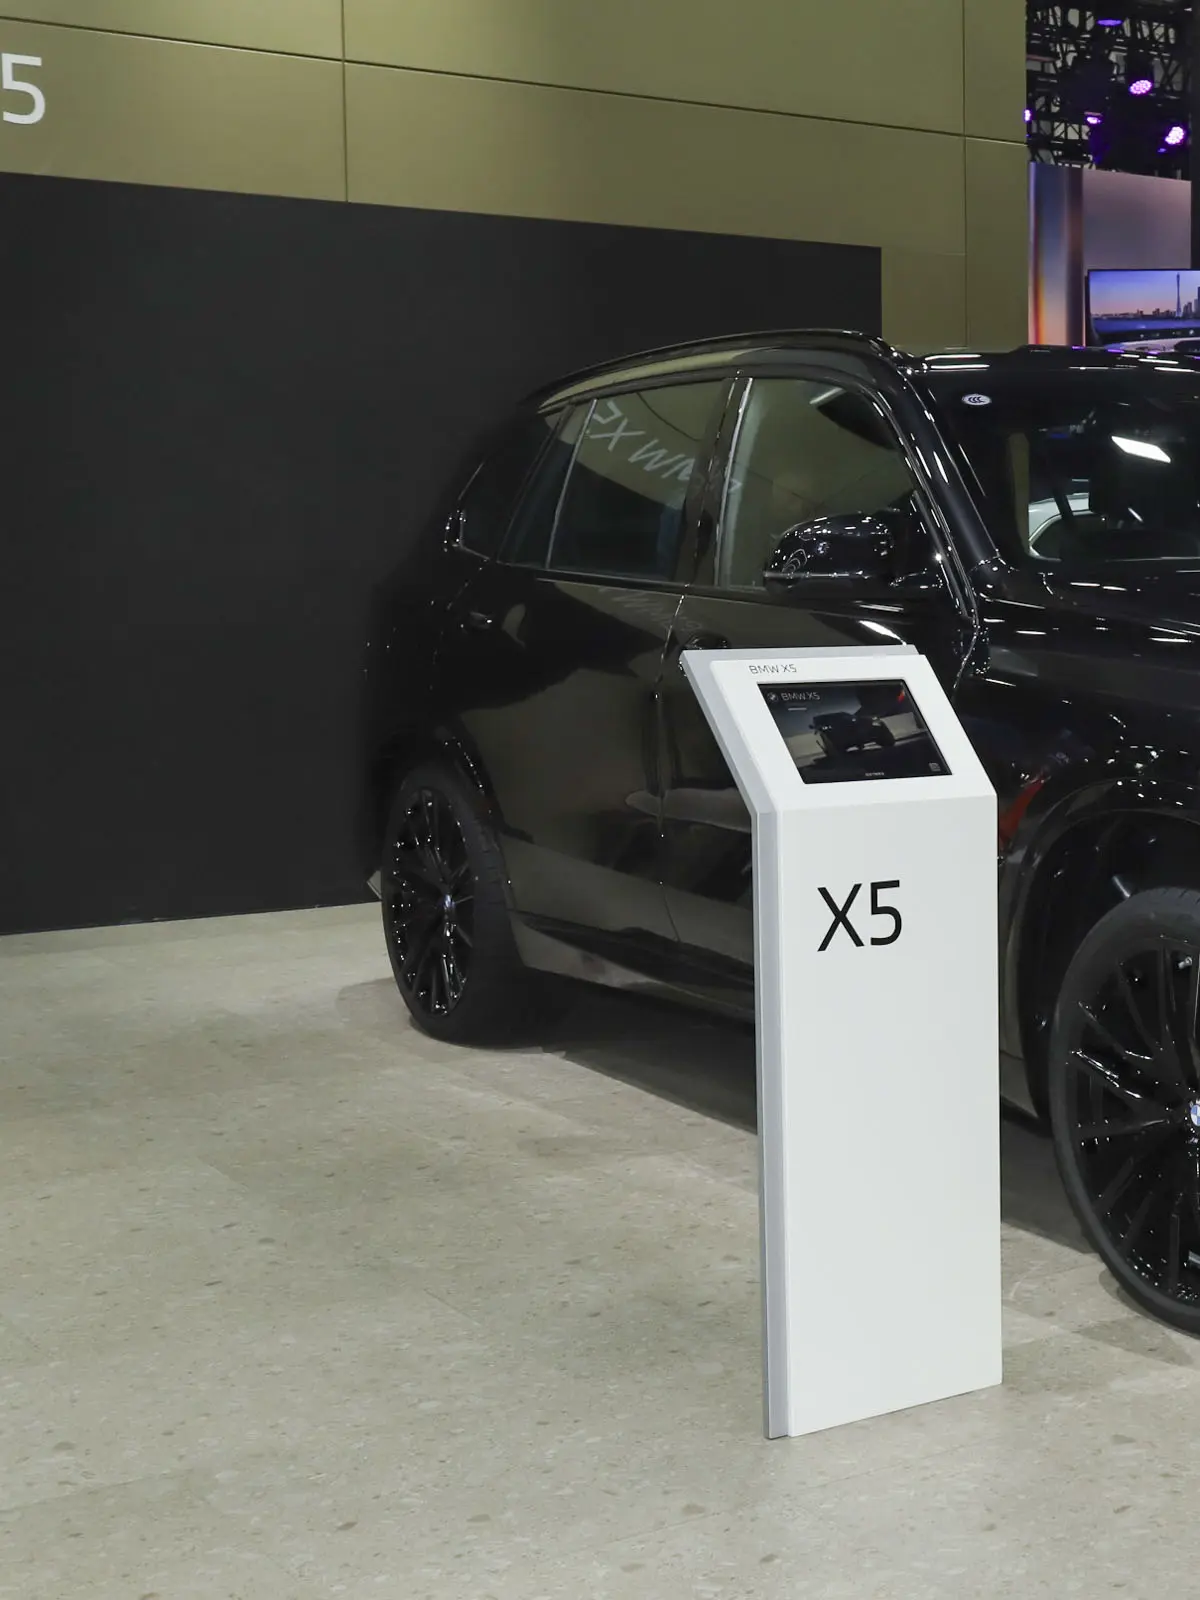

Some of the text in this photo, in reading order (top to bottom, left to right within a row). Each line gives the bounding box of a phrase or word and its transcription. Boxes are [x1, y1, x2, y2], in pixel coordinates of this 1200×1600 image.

[1, 52, 46, 125] 5
[749, 663, 797, 674] BMW X5
[781, 692, 806, 701] BMW
[817, 879, 902, 952] X5
